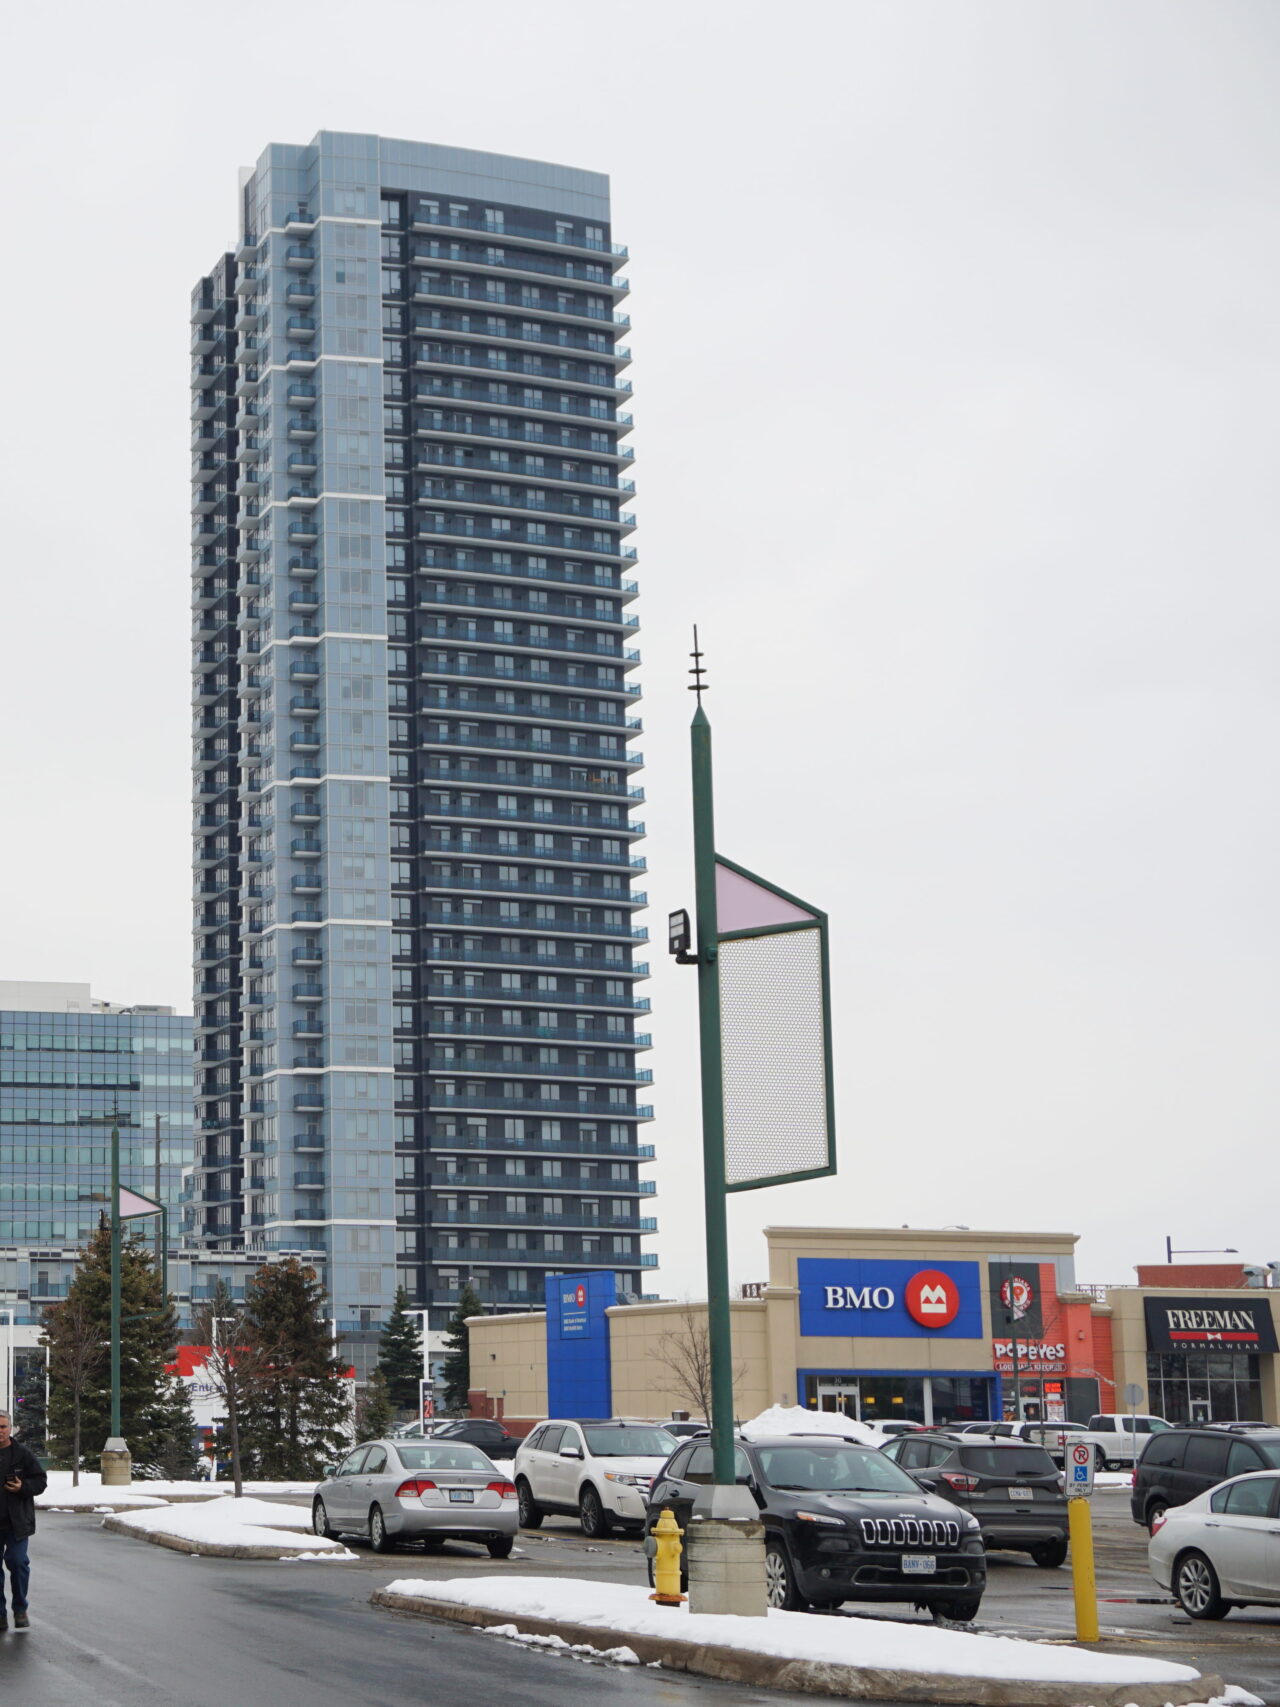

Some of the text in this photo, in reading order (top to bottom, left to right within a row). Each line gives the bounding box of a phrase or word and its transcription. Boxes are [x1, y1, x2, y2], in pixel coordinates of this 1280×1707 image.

[824, 1286, 895, 1309] BMO
[1165, 1309, 1256, 1330] FREEMAN
[1173, 1342, 1260, 1350] FORMALWEAR
